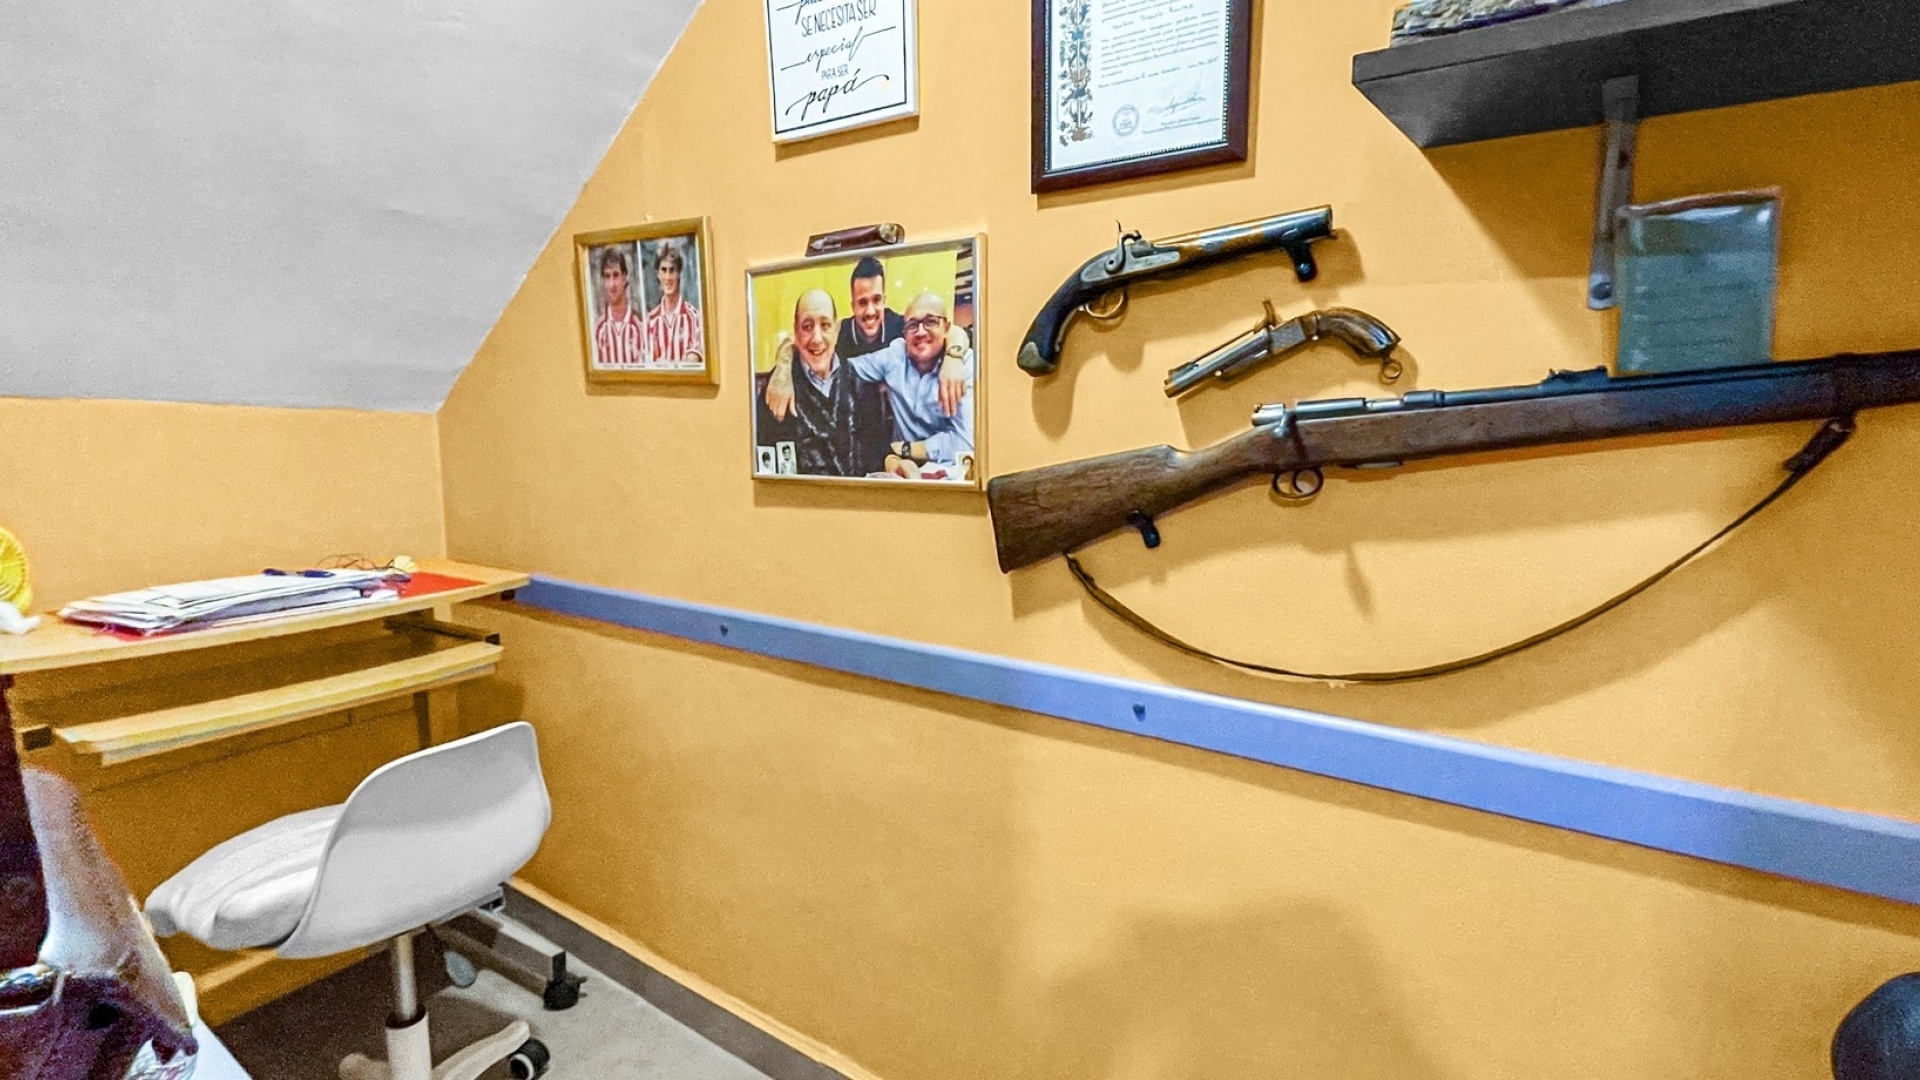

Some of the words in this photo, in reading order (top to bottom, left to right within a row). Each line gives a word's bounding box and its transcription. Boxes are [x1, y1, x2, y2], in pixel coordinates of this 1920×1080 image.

[801, 15, 813, 37] SE
[814, 2, 856, 34] NECESITA
[857, 0, 876, 21] SER
[793, 26, 879, 72] especial
[793, 68, 872, 121] papá
